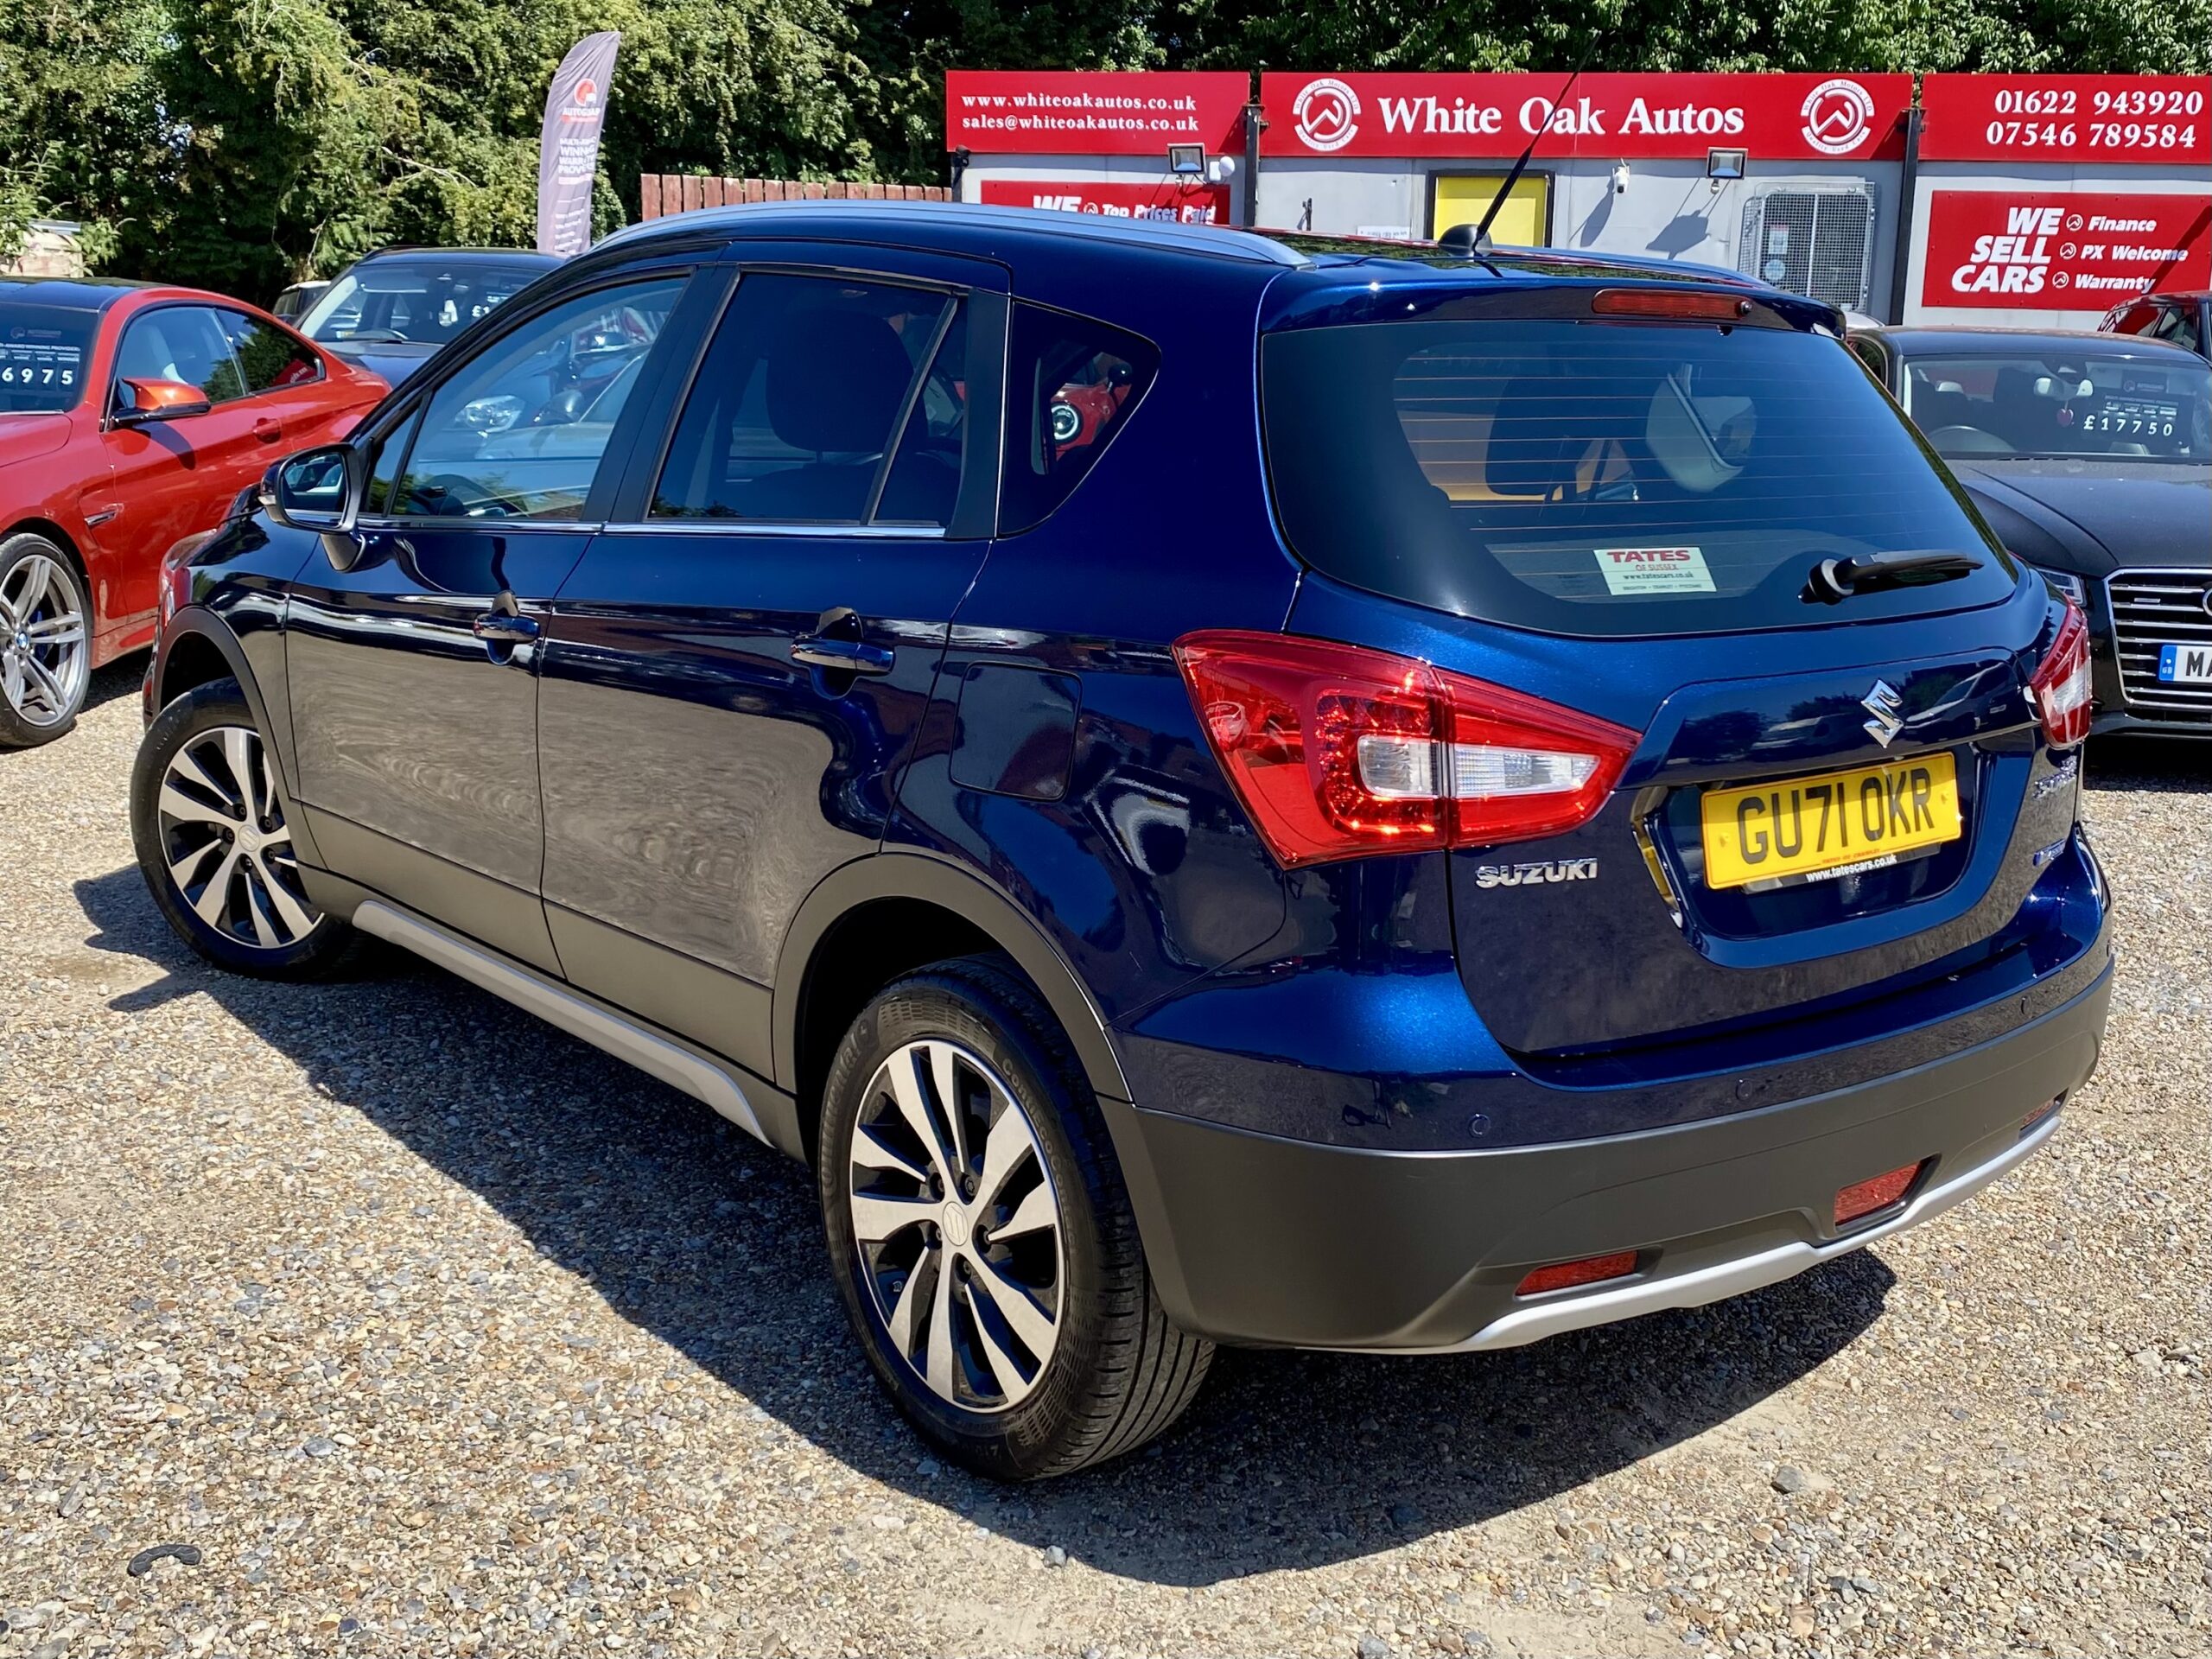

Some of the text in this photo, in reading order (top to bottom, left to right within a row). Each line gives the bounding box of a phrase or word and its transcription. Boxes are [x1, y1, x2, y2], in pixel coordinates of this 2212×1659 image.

[962, 92, 1196, 111] www.whiteoakautos.co.uk
[1994, 89, 2203, 116] 01622 943920
[962, 114, 1199, 131] sales@whiteoakautos.co.uk
[1377, 96, 1745, 135] White Oak Autos
[1986, 121, 2196, 148] 07546 789584
[1102, 204, 1217, 223] Top Prices Paid
[2007, 207, 2065, 236] WE
[2087, 215, 2157, 232] Finance
[1970, 235, 2052, 264] SELL
[2080, 244, 2189, 262] PX Welcome
[1951, 264, 2046, 294] CARS
[2075, 273, 2156, 295] Warranty
[1606, 550, 1691, 563] TATES
[1737, 767, 1935, 865] GU71 OKR
[1475, 858, 1598, 888] SUZUKI
[1806, 854, 1897, 882] www.tatescars.co.uk
